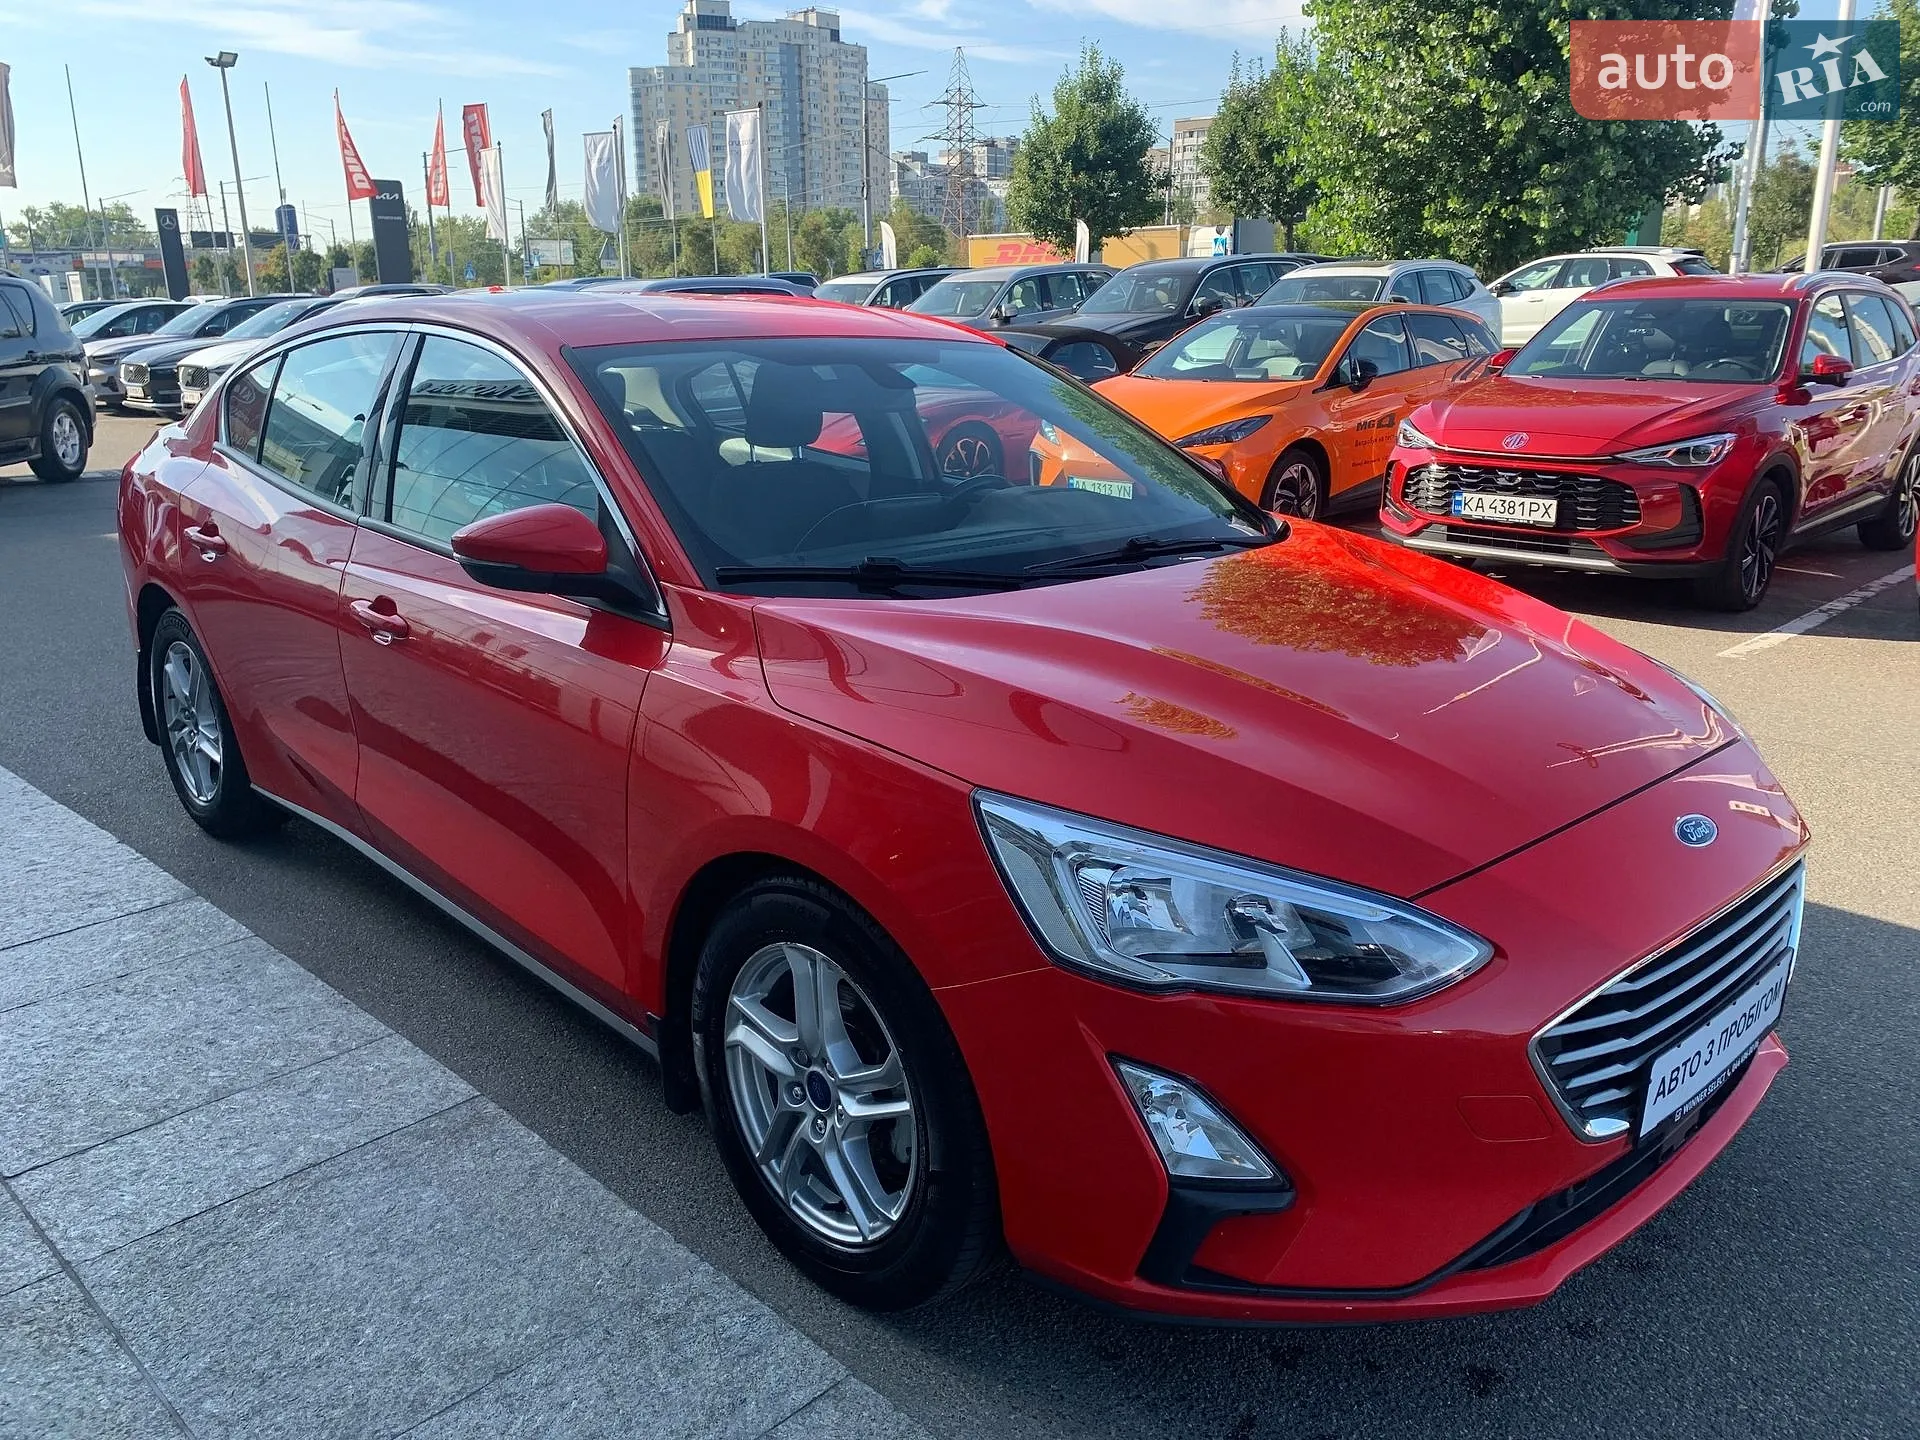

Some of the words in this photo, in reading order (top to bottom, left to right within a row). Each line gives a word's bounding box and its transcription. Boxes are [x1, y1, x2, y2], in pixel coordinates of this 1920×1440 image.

[1683, 820, 1711, 841] Ford
[1653, 1050, 1702, 1105] АВТО
[1717, 977, 1783, 1056] ПРОБІГОМ
